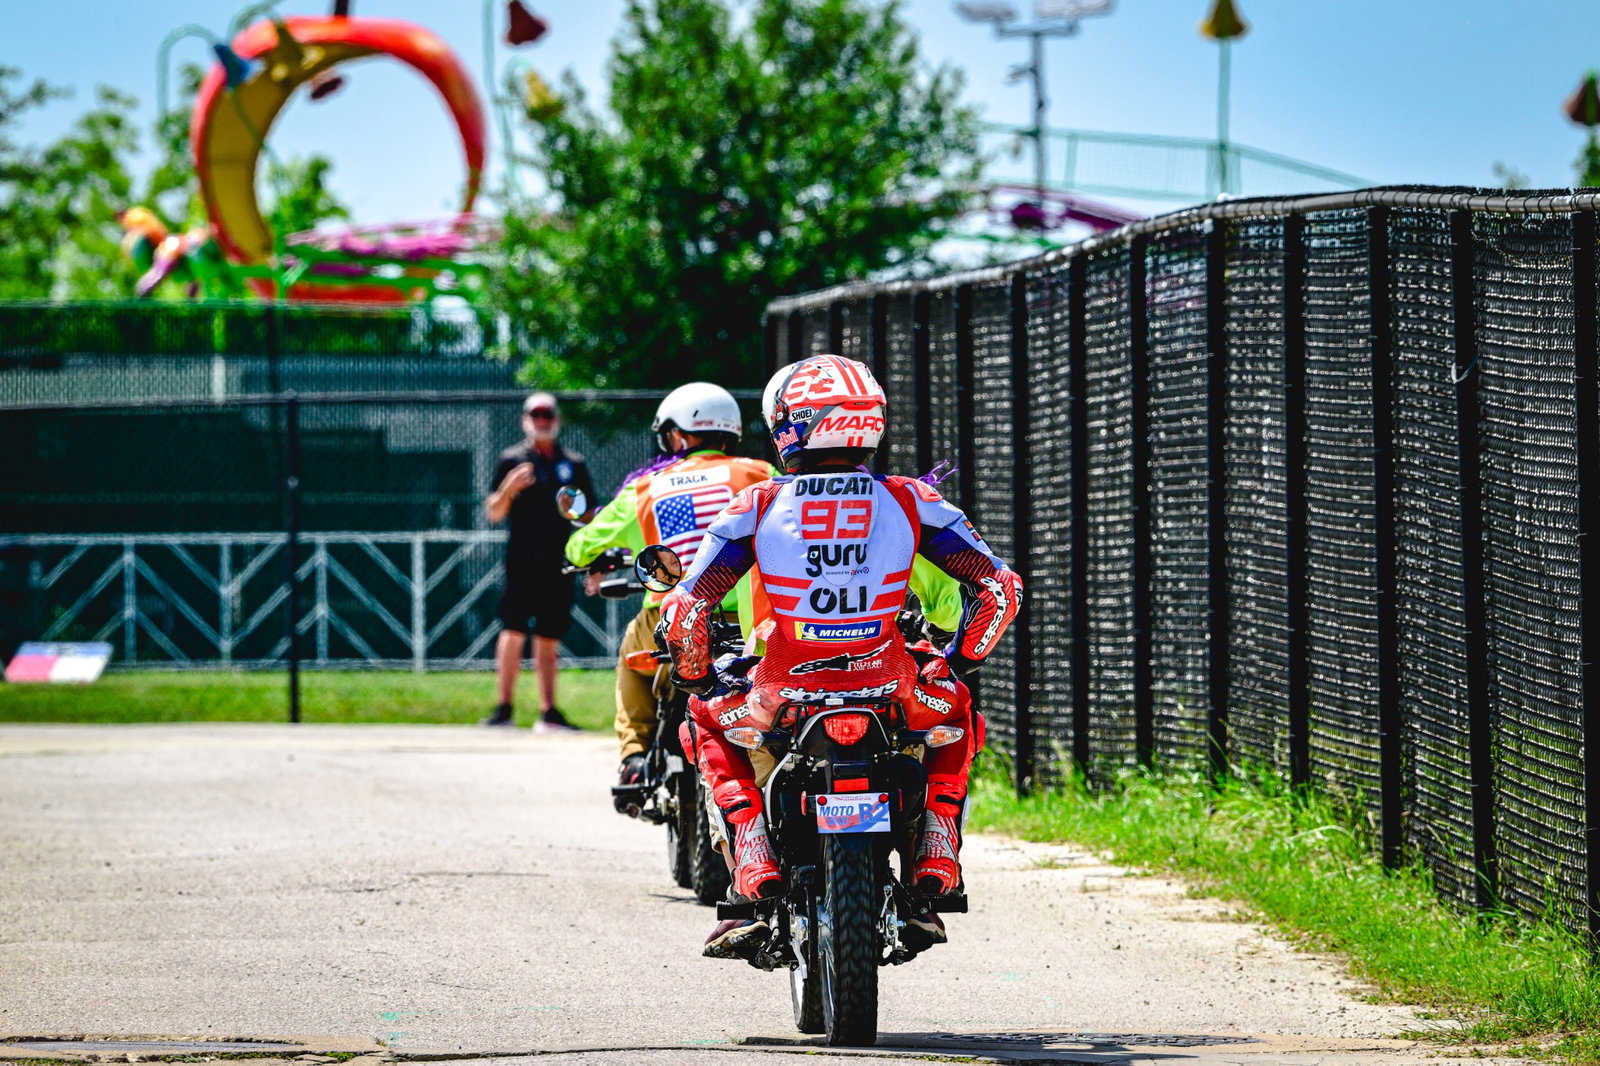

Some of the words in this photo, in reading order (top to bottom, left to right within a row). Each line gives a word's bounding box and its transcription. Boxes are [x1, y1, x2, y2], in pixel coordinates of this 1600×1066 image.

[791, 408, 812, 421] SHOEI
[815, 415, 885, 433] MARC
[669, 474, 708, 486] TRACK
[795, 477, 873, 496] DUCATI
[801, 499, 872, 539] 93
[805, 544, 867, 577] guru
[819, 626, 875, 637] MICHELIN
[718, 702, 751, 728] alpines
[819, 805, 855, 817] MOTO
